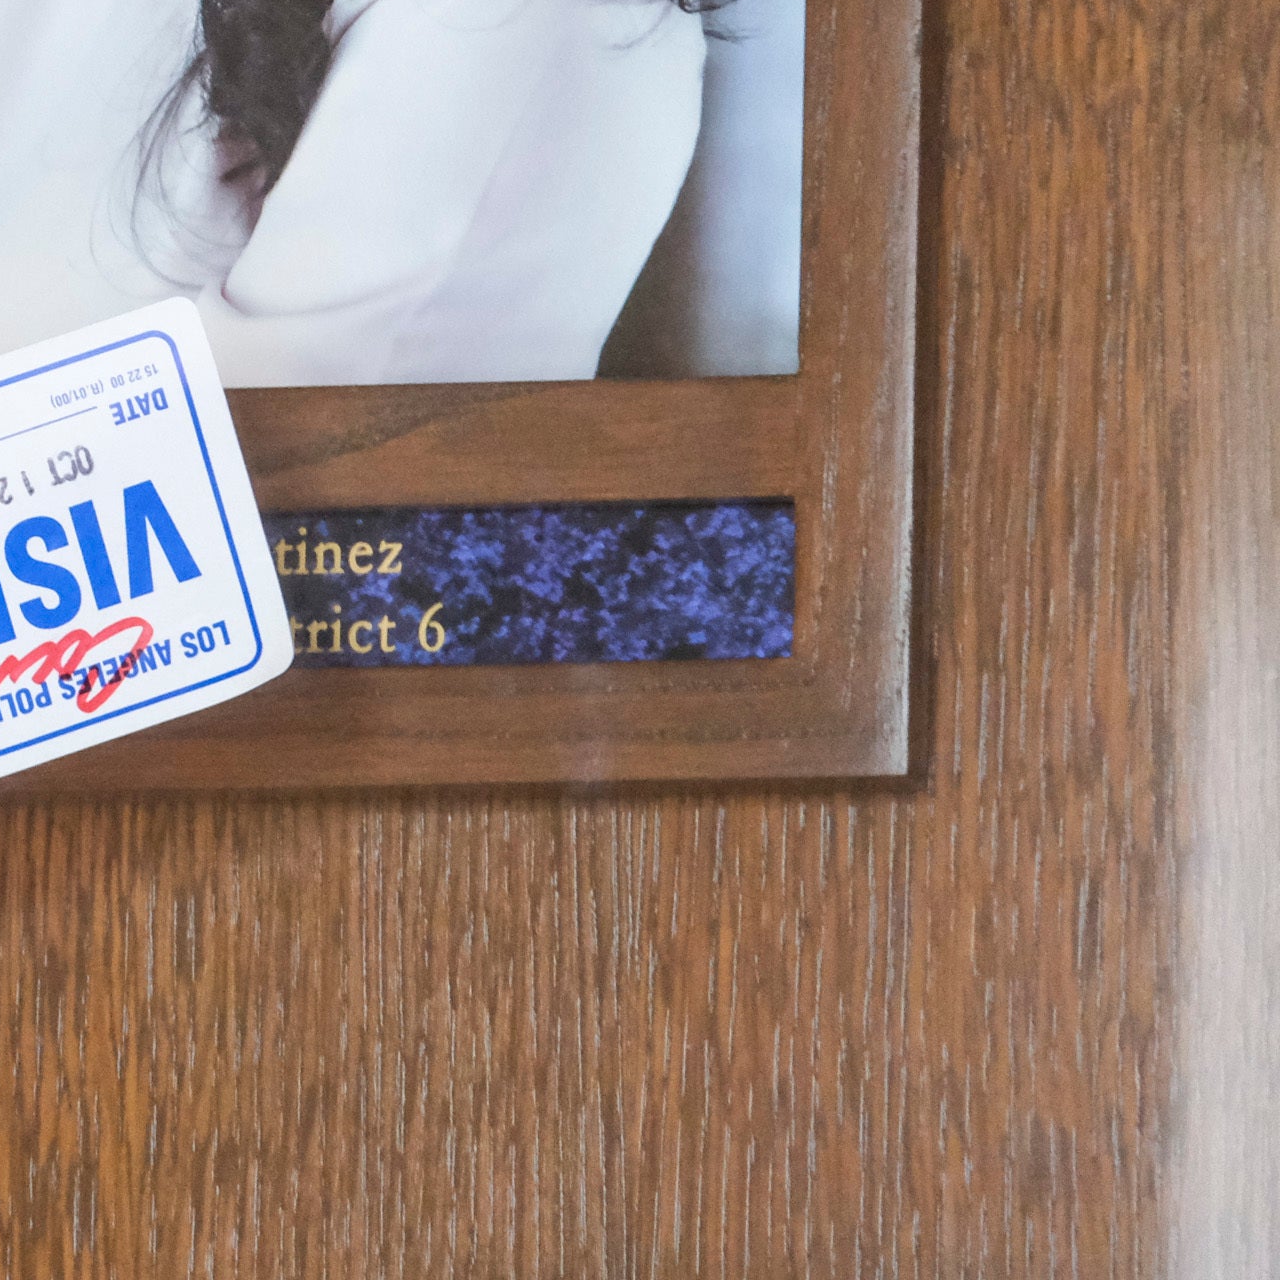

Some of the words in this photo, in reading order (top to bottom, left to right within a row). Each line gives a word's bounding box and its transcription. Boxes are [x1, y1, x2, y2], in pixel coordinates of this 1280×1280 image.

[110, 374, 125, 389] 00
[127, 368, 142, 383] 22
[144, 363, 158, 377] 15
[109, 387, 168, 426] DATE
[47, 444, 95, 487] OCT
[275, 526, 403, 576] tinez
[182, 620, 232, 658] LOS
[291, 603, 397, 654] trict
[419, 602, 445, 653] 6
[60, 639, 172, 699] ANGELES
